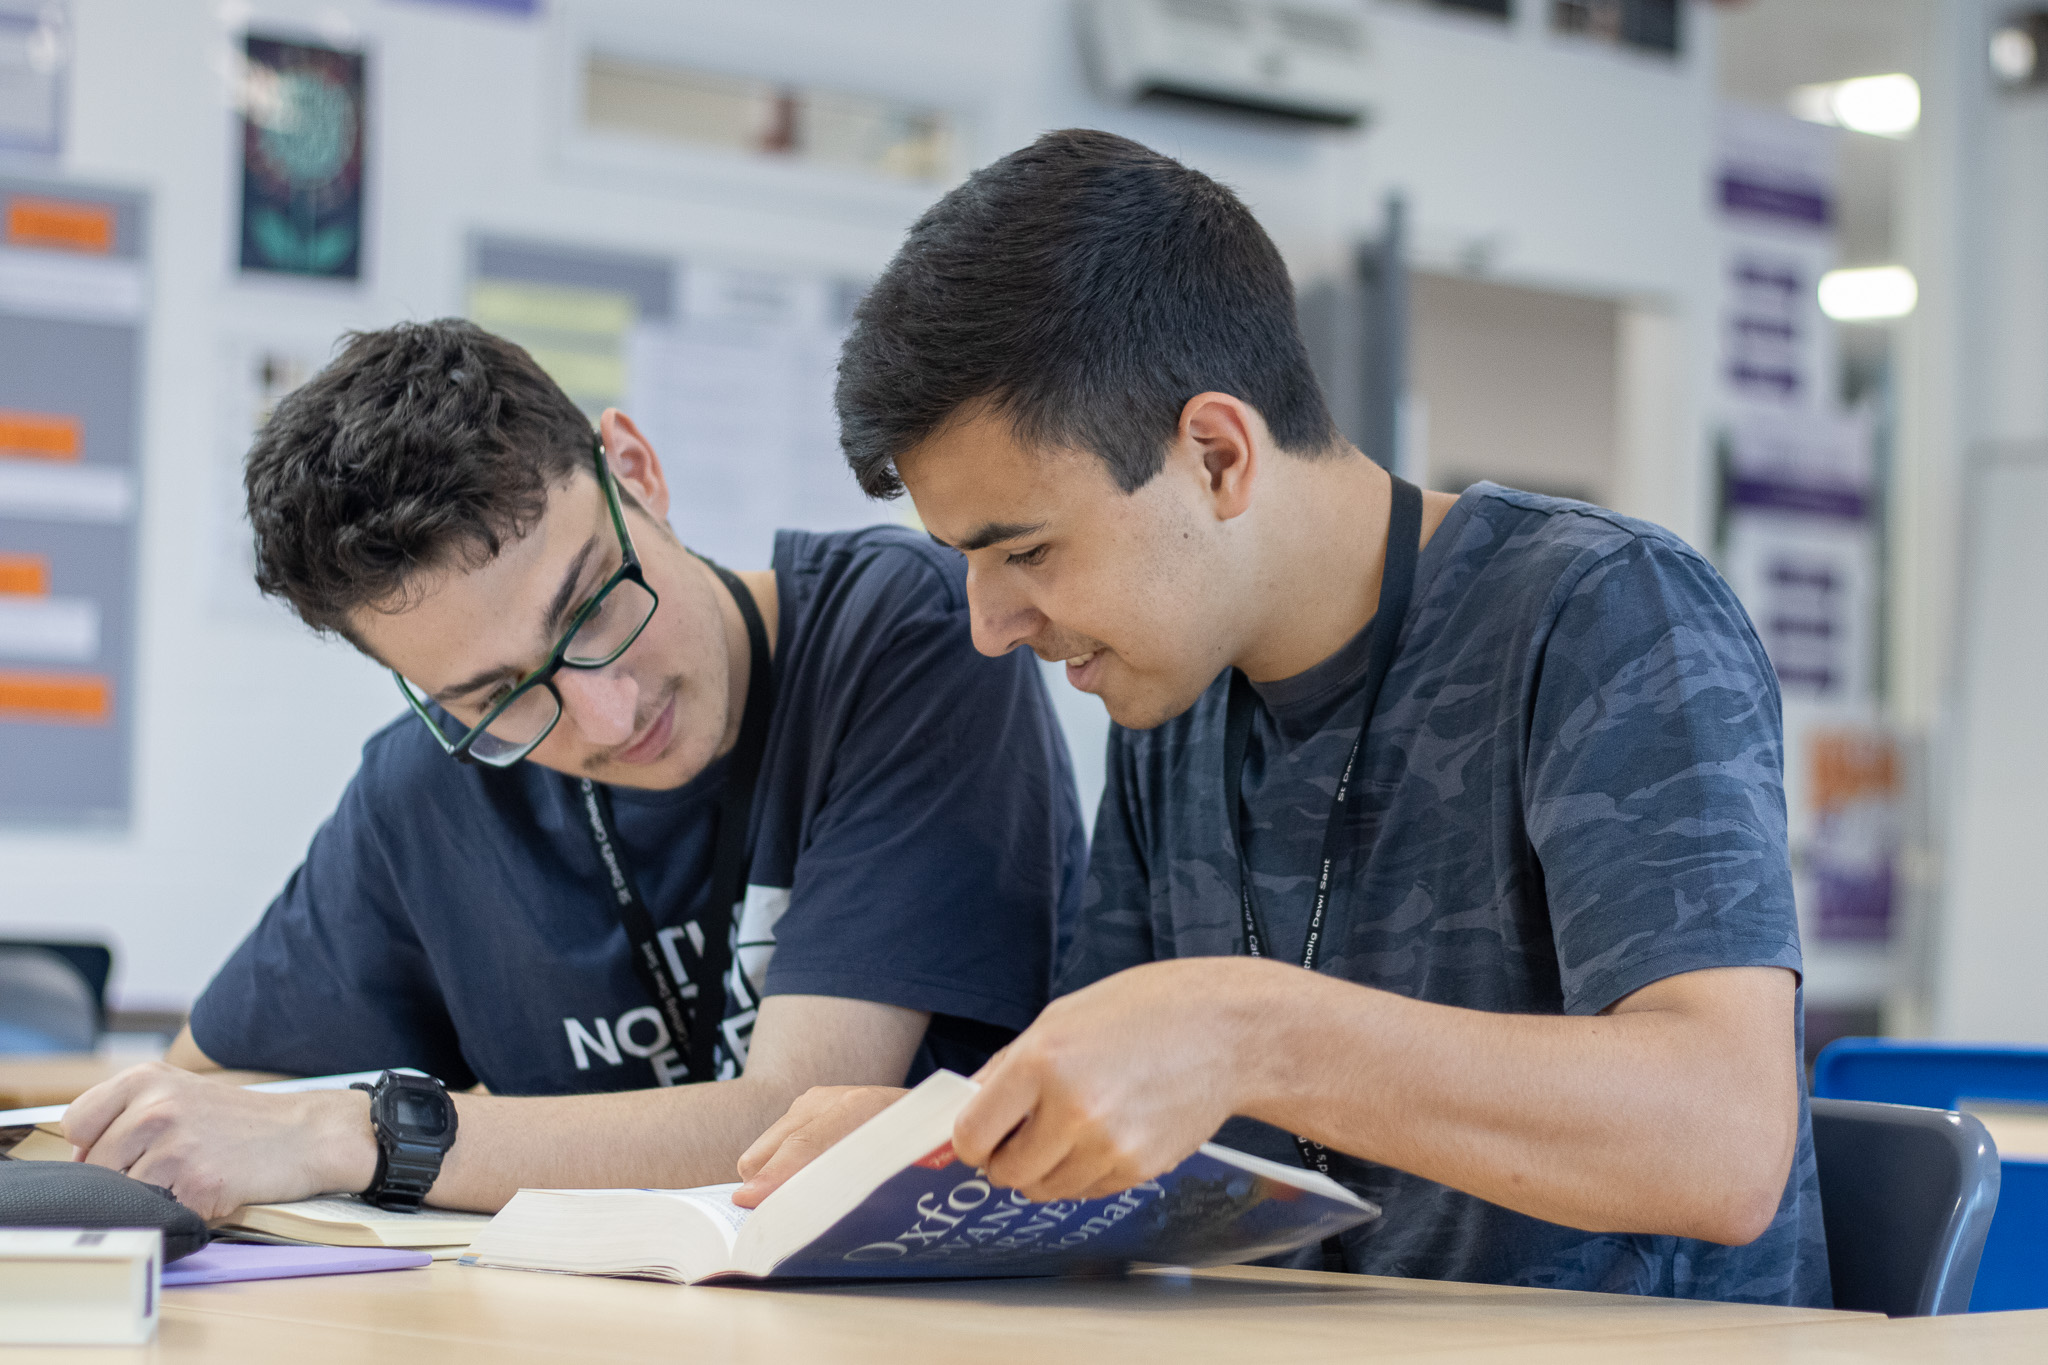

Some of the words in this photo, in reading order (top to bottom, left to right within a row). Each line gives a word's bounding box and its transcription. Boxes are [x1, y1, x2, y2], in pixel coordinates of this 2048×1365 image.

[1337, 786, 1345, 802] St
[1304, 931, 1318, 969] tholig
[1311, 893, 1324, 927] Dewi
[1319, 857, 1330, 890] Sant
[1248, 934, 1261, 958] Cat
[842, 1168, 992, 1262] Oxfo
